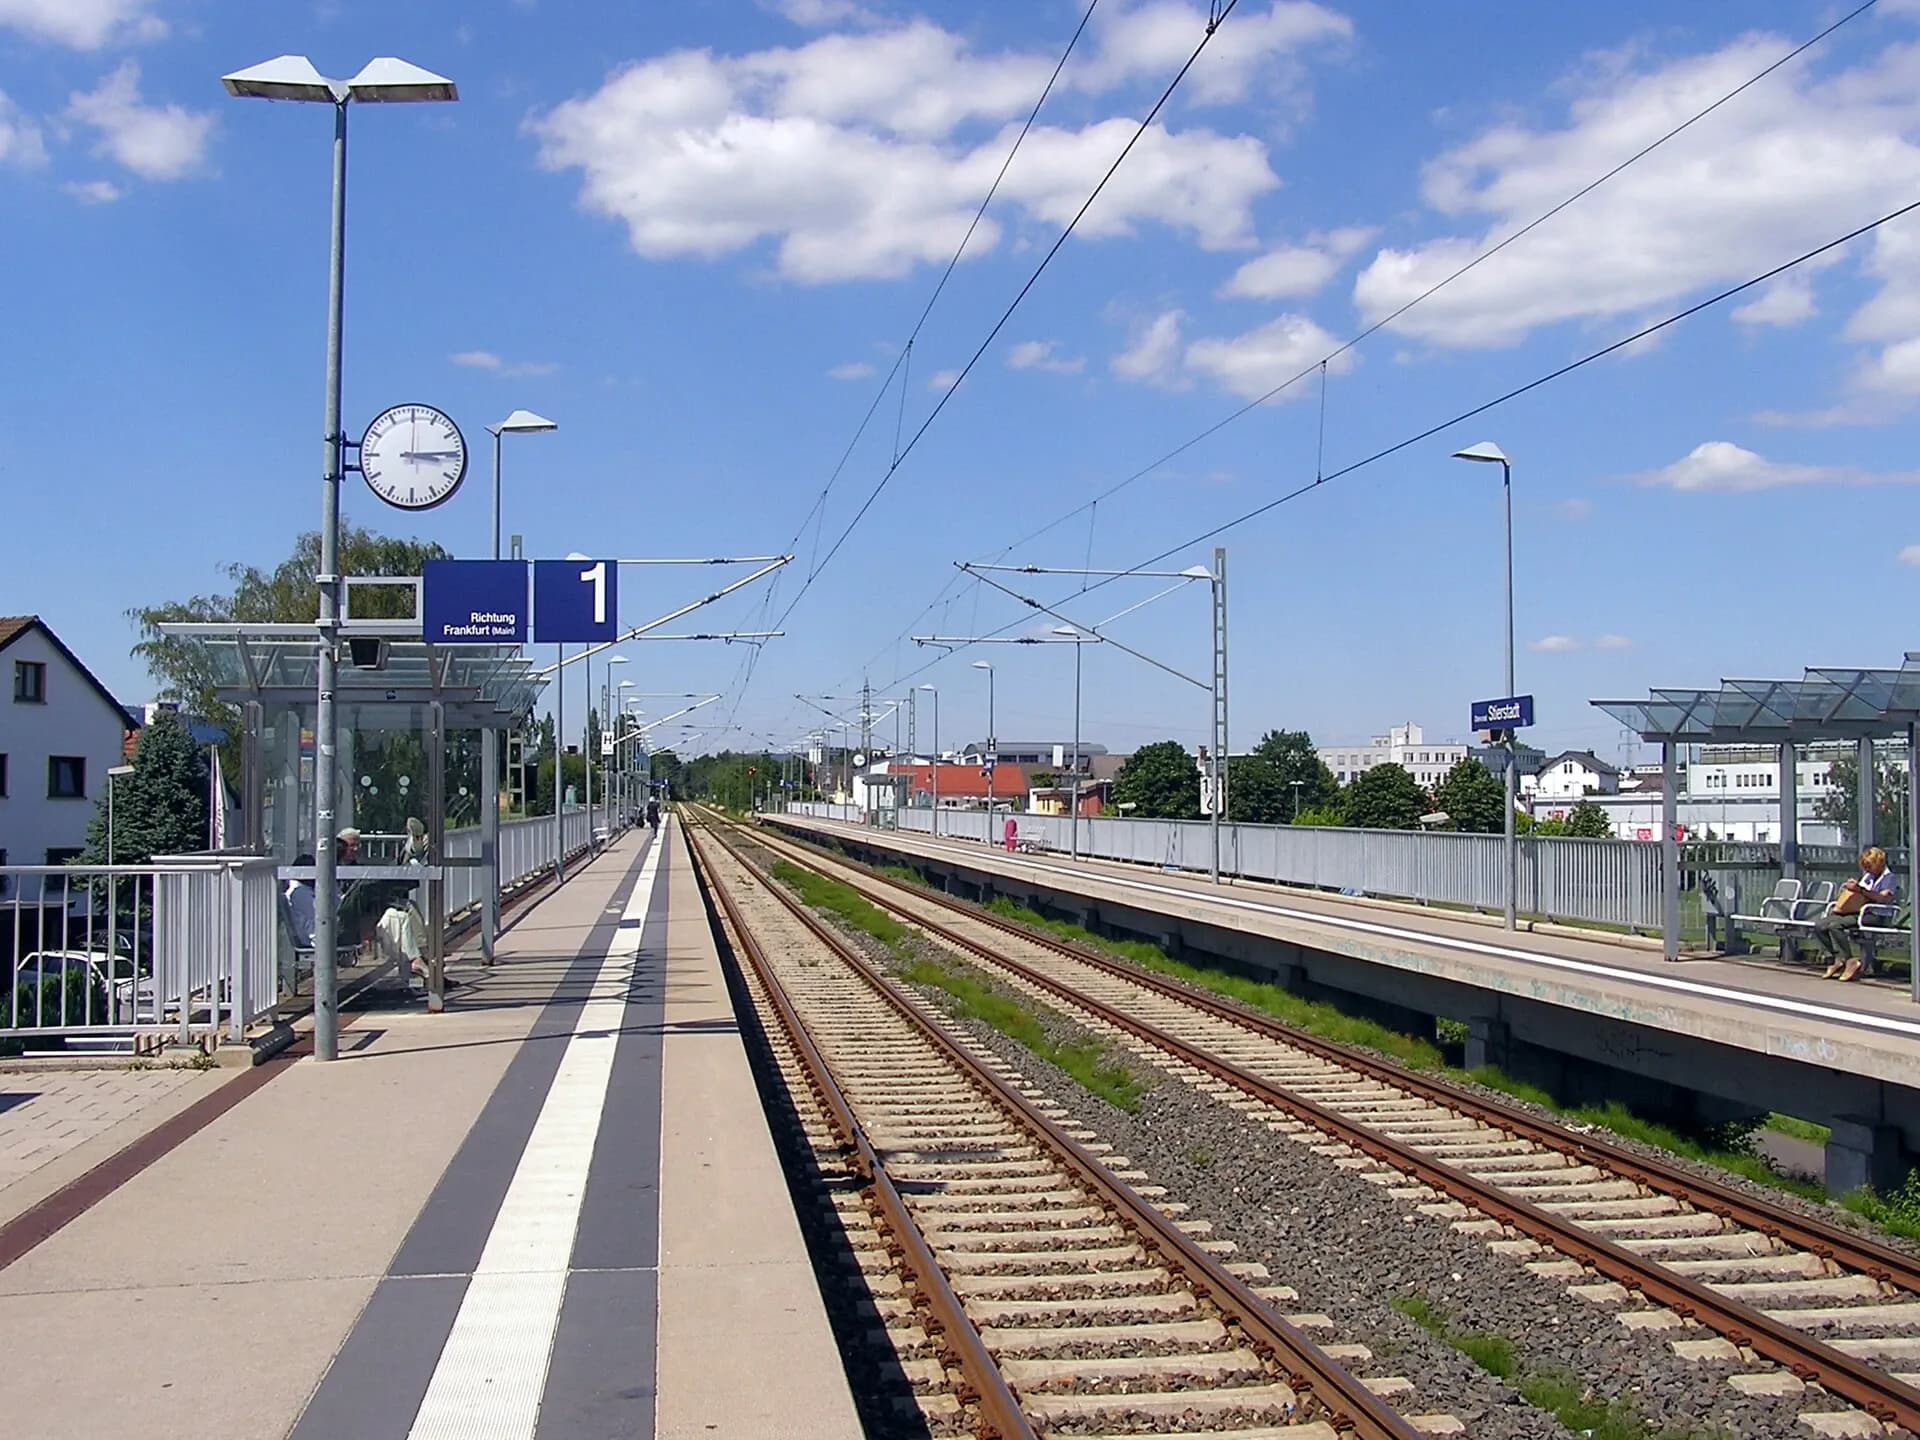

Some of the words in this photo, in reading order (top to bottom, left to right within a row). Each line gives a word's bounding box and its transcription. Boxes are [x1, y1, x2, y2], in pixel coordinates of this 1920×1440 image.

[580, 562, 606, 623] 1
[471, 612, 516, 625] Richtung
[443, 625, 490, 635] Frankfurt
[491, 626, 516, 636] (Main)
[604, 735, 612, 745] H
[987, 738, 996, 751] H
